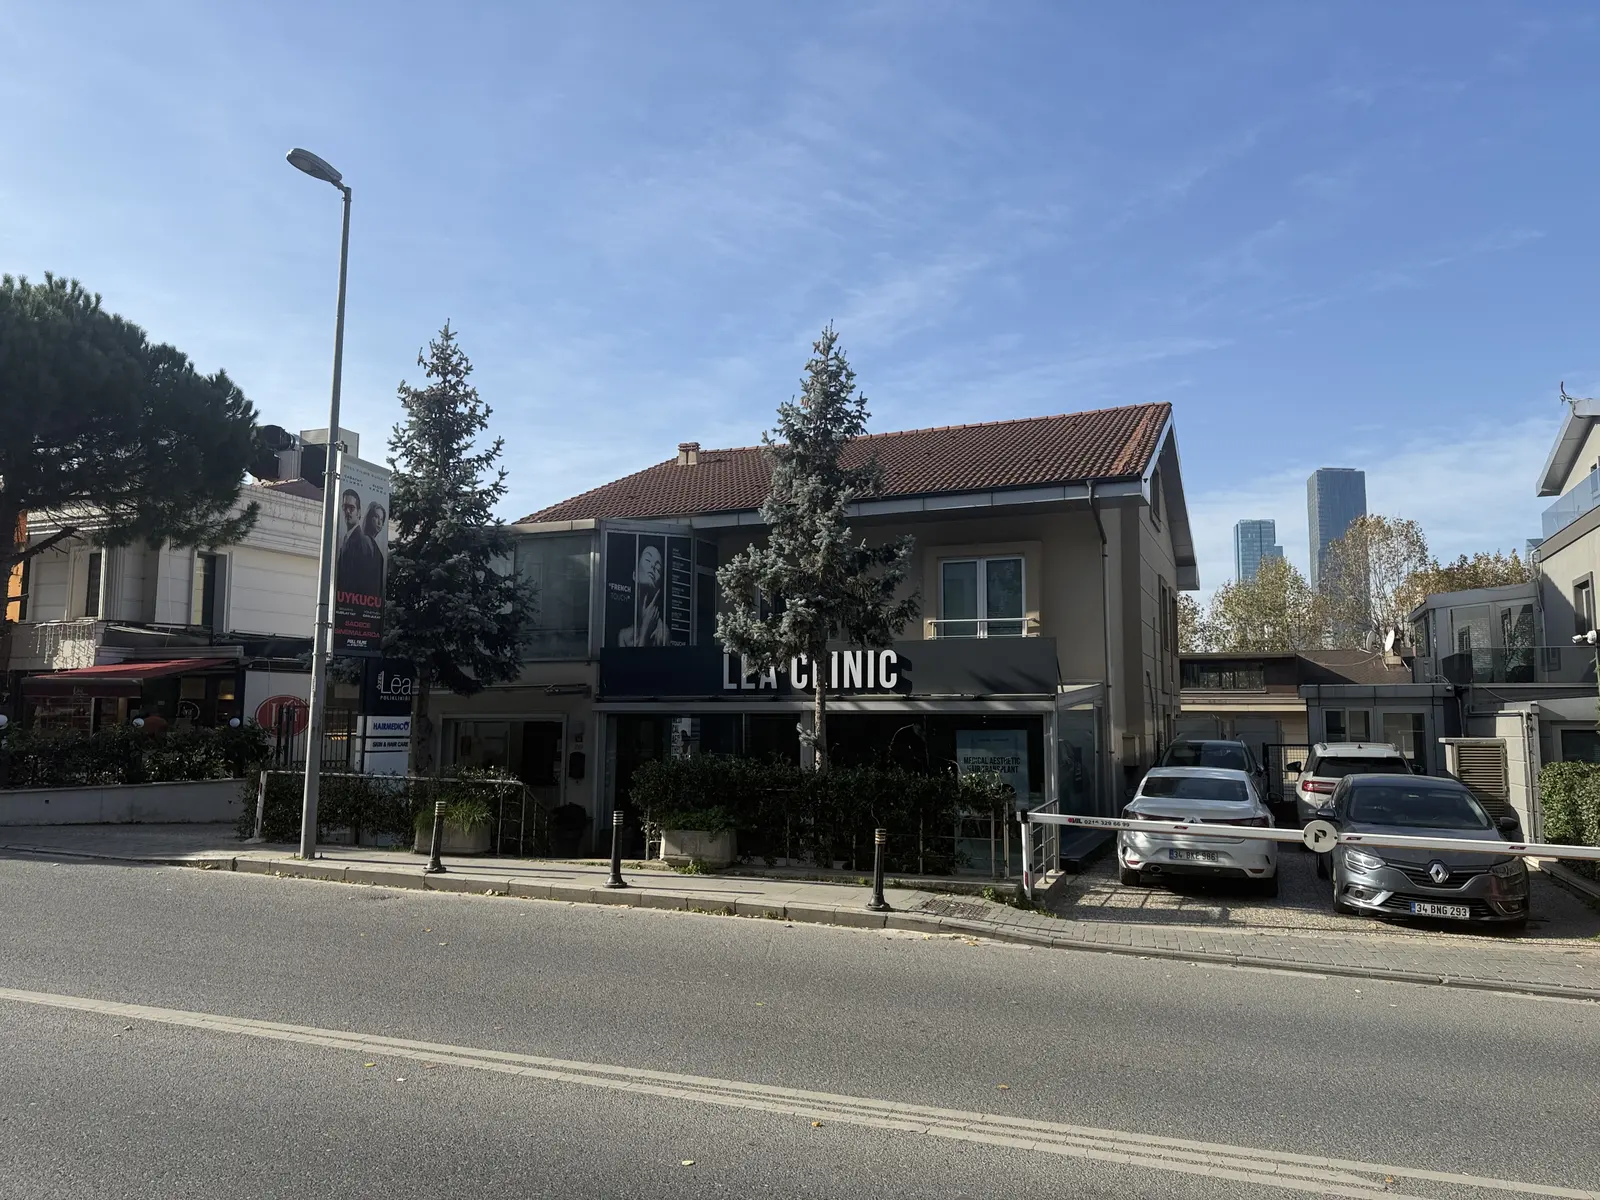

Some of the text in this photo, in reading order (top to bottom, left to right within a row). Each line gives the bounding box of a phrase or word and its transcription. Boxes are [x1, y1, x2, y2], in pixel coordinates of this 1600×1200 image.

[337, 591, 382, 608] UYKUCU
[373, 721, 410, 731] HAIRMEDICO
[963, 756, 1021, 765] MEDICAL AESTHETIC
[1314, 829, 1327, 843] P
[1173, 850, 1183, 859] 34
[1416, 903, 1467, 917] 34 BNG 293
